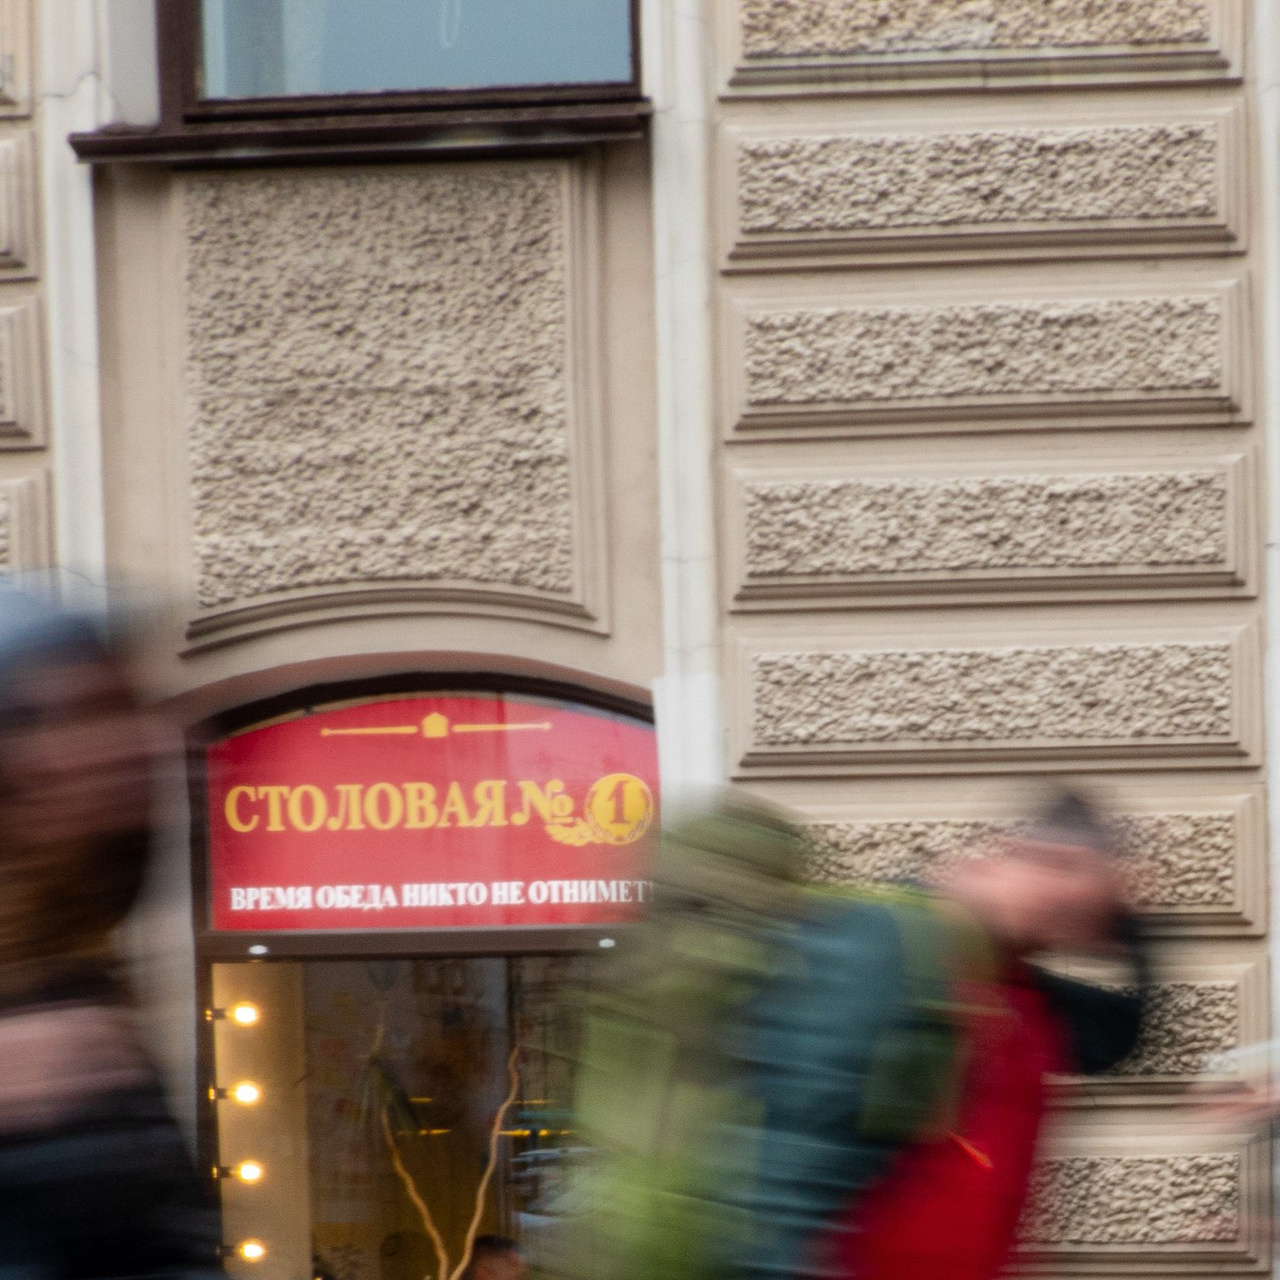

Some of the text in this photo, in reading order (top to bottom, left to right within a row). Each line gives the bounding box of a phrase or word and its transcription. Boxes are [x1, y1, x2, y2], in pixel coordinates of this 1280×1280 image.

[224, 779, 509, 833] СТОЛОВАЯ
[510, 778, 575, 826] №
[229, 885, 314, 911] ВРЕМЯ
[316, 884, 398, 912] ОБЕДА
[402, 881, 488, 908] НИКТО
[491, 880, 525, 906] НЕ
